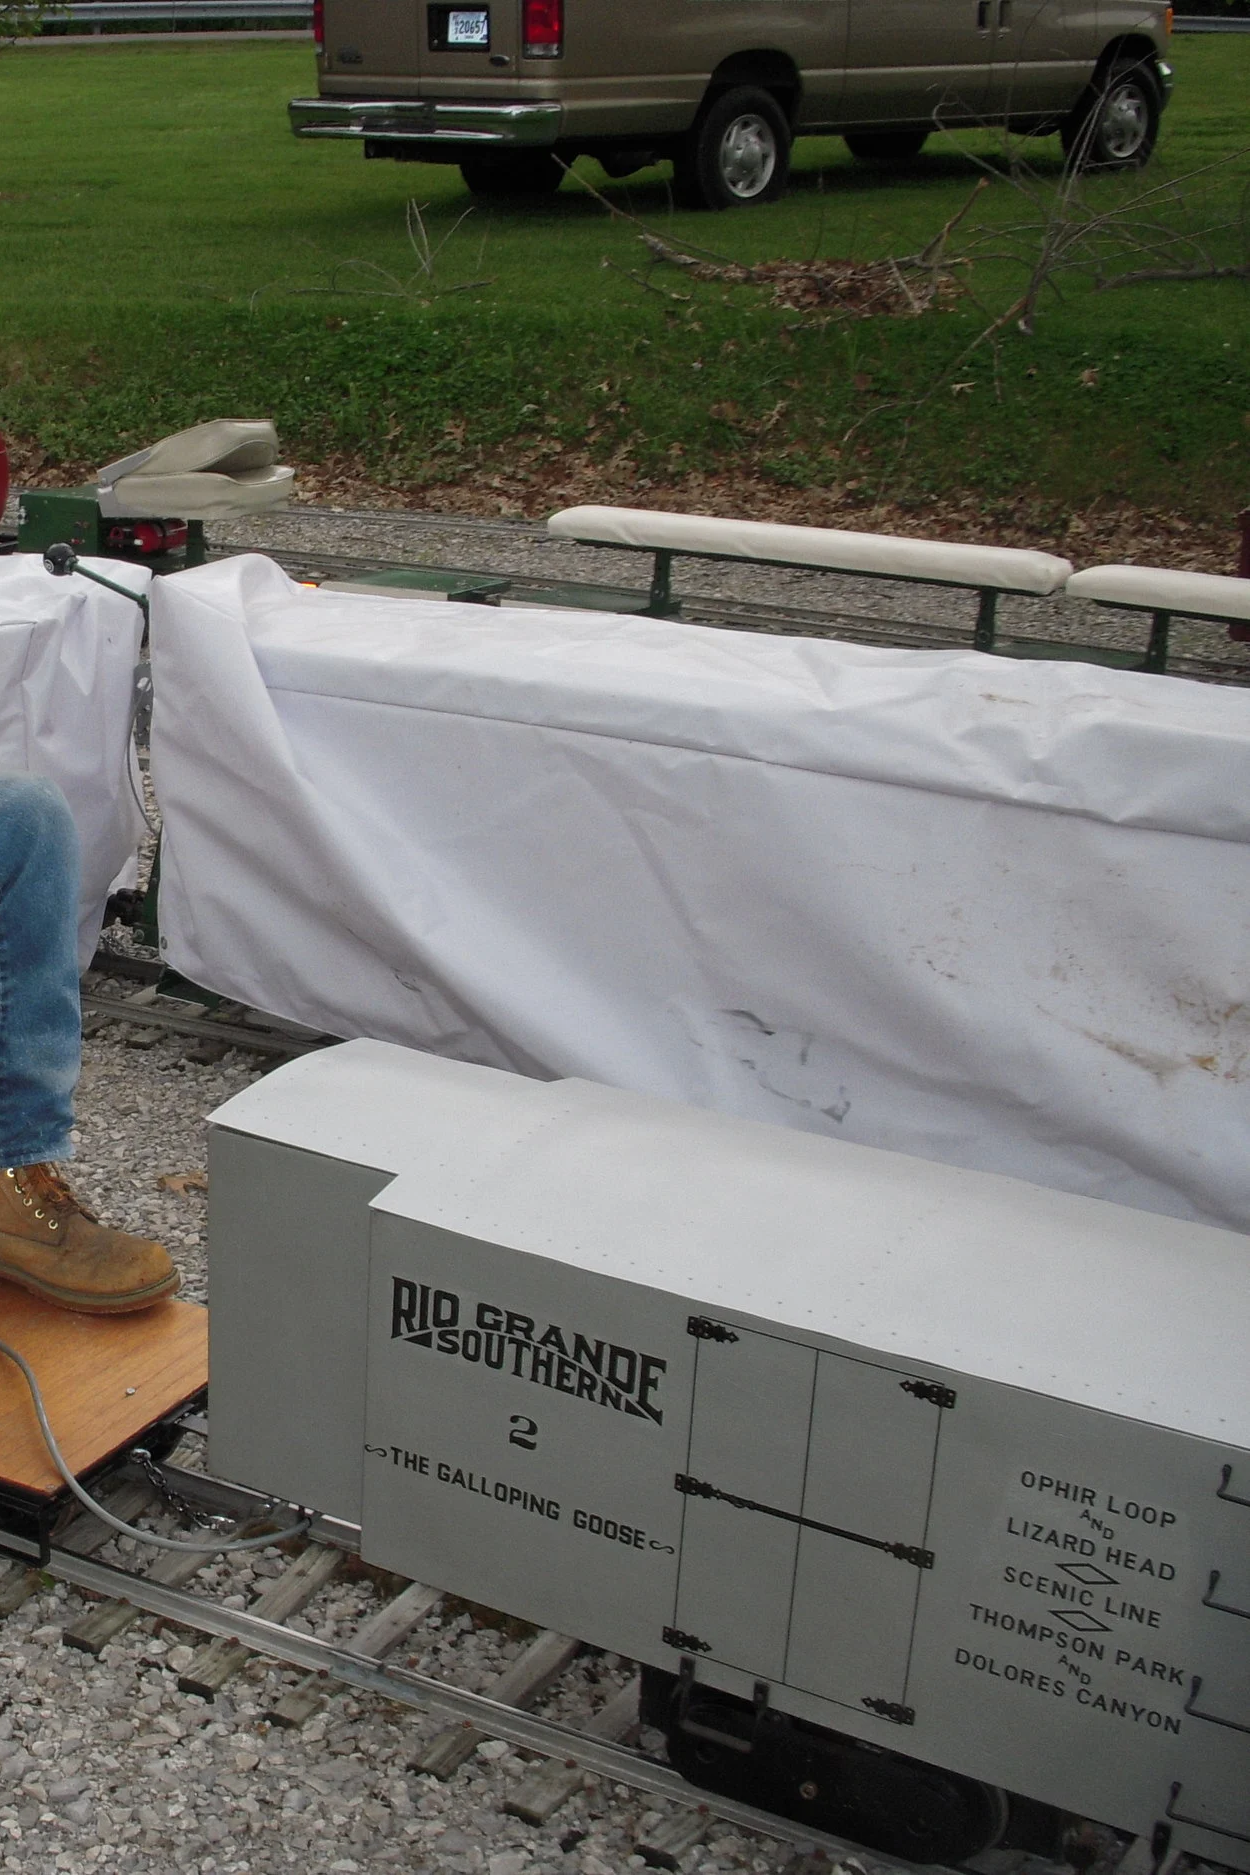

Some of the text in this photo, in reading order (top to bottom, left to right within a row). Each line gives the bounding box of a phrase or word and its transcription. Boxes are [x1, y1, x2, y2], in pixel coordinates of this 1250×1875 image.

[391, 1275, 668, 1426] RIO GRANDE
[436, 1329, 624, 1412] SOUTHERN
[508, 1414, 539, 1451] 2
[390, 1446, 647, 1551] THE GALLOPING GOOSE
[1020, 1470, 1177, 1529] OPHIR LOOP
[1080, 1508, 1115, 1541] AND
[1006, 1516, 1176, 1582] LIZARD HEAD
[1003, 1566, 1162, 1630] SCENIC LINE
[969, 1602, 1187, 1687] THOMPSON PARK
[1057, 1653, 1092, 1686] AND
[954, 1647, 1182, 1736] DOLORES CANYON
